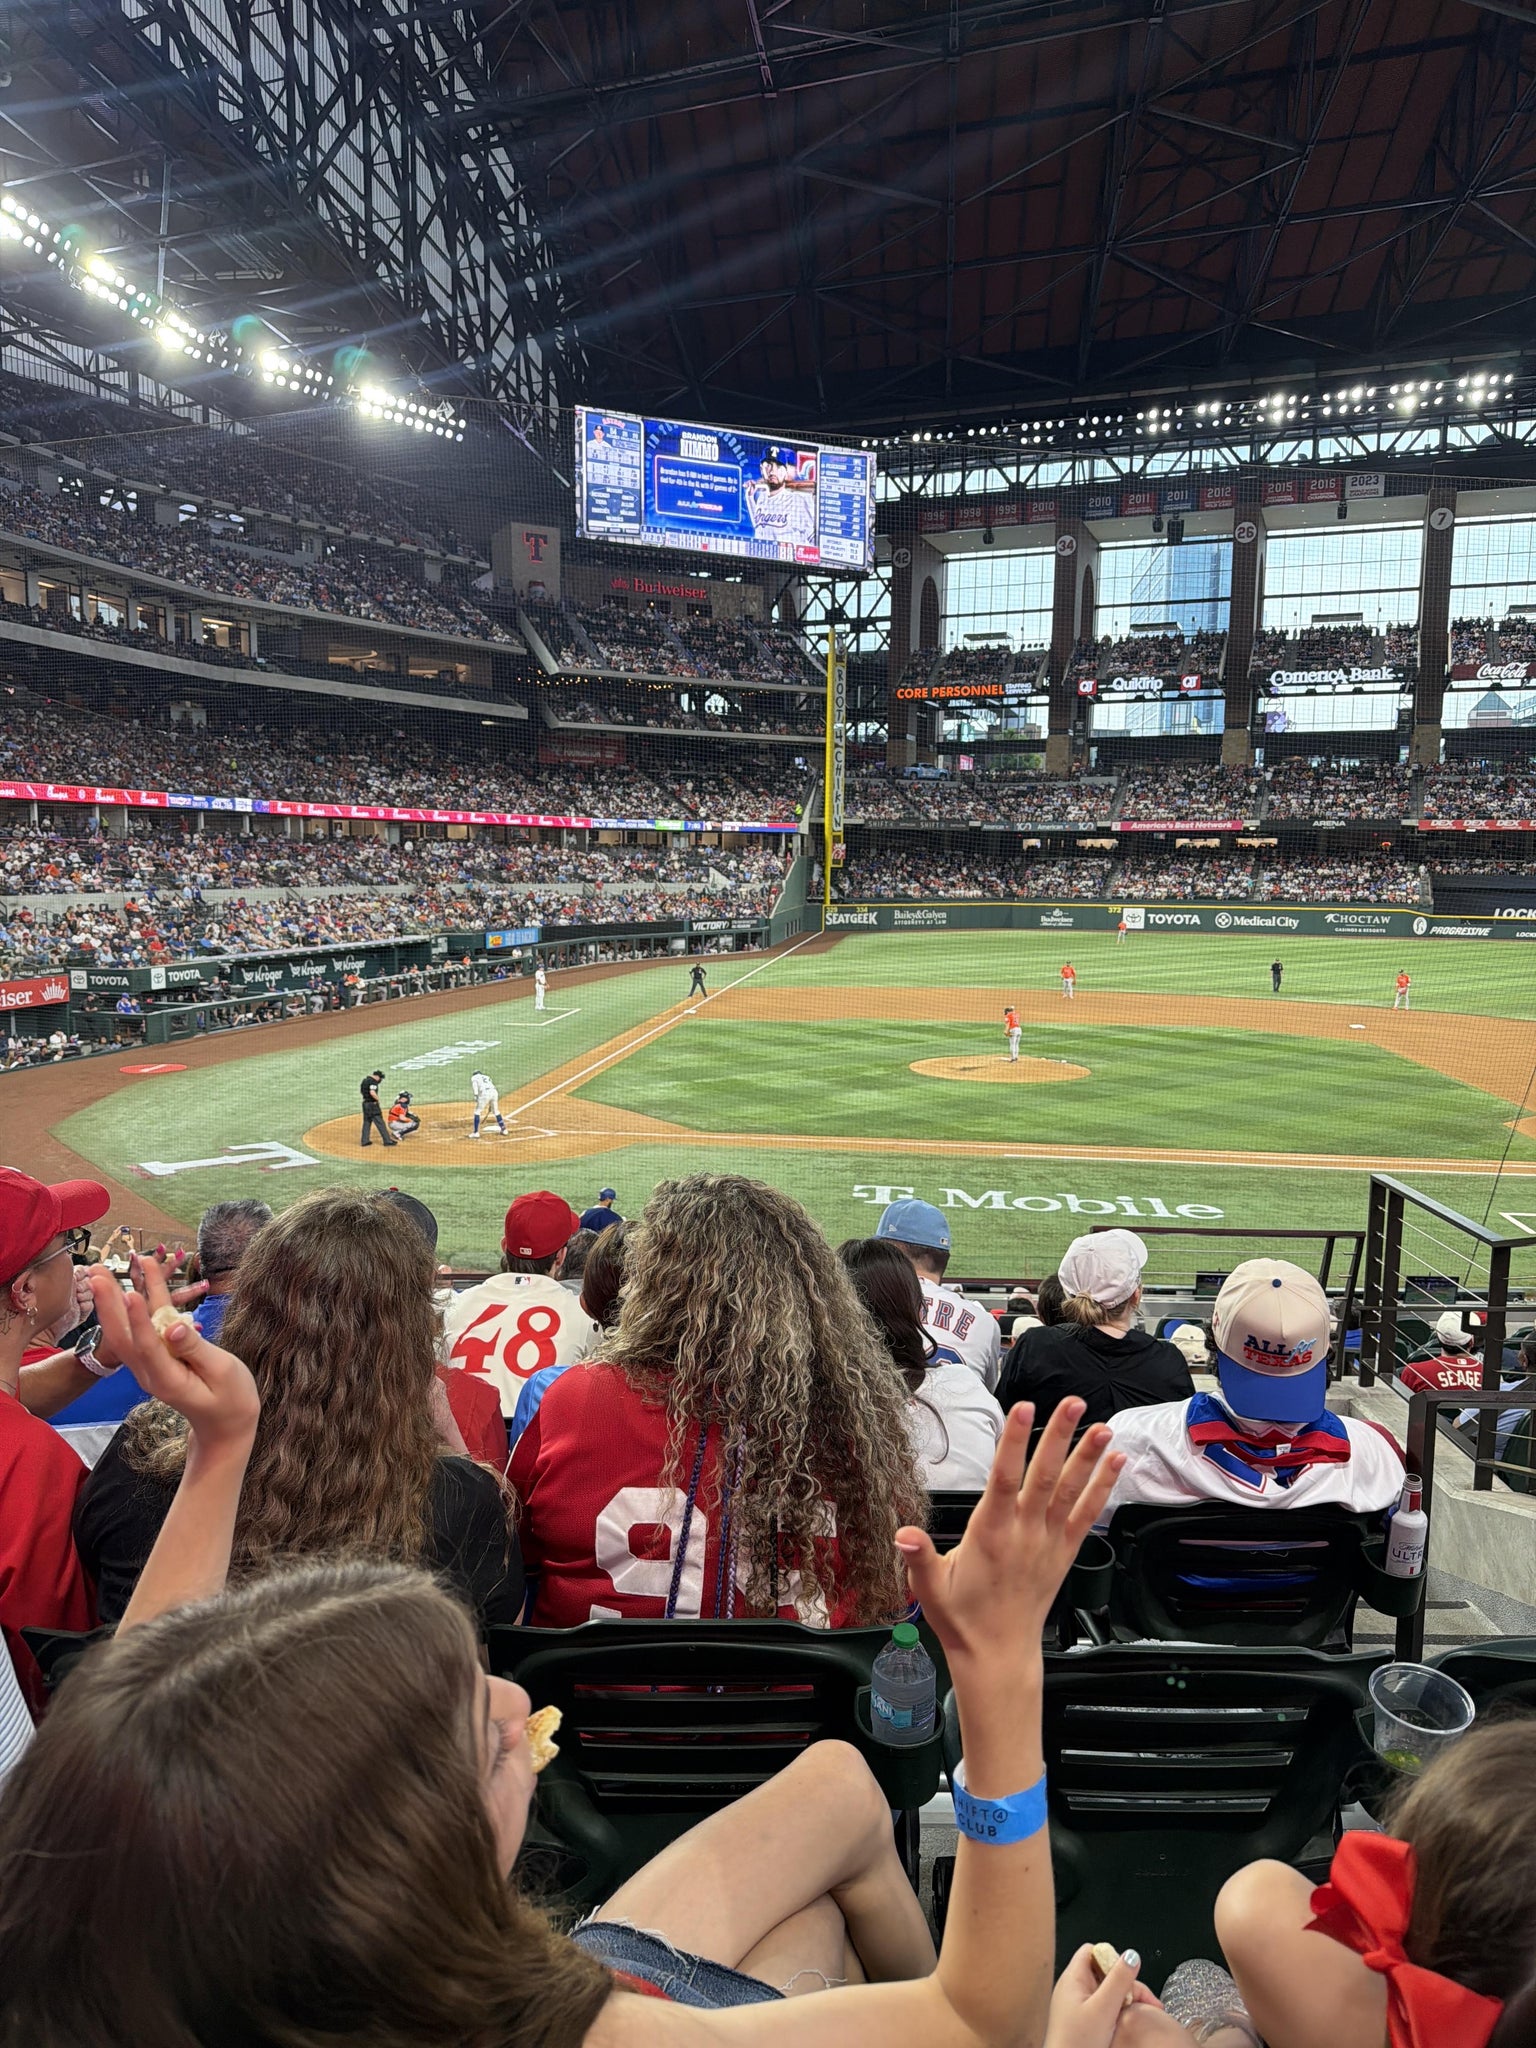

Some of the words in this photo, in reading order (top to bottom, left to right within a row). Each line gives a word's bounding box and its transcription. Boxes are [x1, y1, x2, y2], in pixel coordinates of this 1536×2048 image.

[681, 431, 718, 444] BRANDON
[680, 438, 719, 462] NIMMO
[1268, 482, 1293, 493] 2015
[1311, 479, 1336, 490] 2016
[1351, 475, 1380, 487] 2023
[1167, 490, 1188, 501] 2011
[1207, 487, 1231, 498] 2012
[1088, 496, 1112, 508] 2010
[1128, 494, 1150, 505] 2011
[959, 508, 981, 519] 1998
[995, 504, 1017, 516] 1999
[1032, 501, 1055, 513] 2010
[1437, 511, 1447, 525] 7
[1237, 526, 1255, 539] 26
[522, 530, 548, 563] T
[1058, 539, 1075, 552] 34
[893, 552, 910, 565] 42
[1349, 666, 1396, 681] Bank
[1476, 662, 1530, 679] Coca-Cola
[1079, 680, 1095, 693] QT
[1112, 676, 1164, 692] QuikTrip
[1182, 676, 1198, 688] QT
[835, 668, 845, 722] ROOT
[896, 687, 929, 699] CORE
[931, 684, 1005, 698] PERSONNEL
[835, 728, 843, 743] 4
[834, 750, 843, 829] CHIKIN
[1130, 821, 1176, 829] America's
[1177, 821, 1194, 829] Best
[1194, 821, 1233, 830] Network
[825, 911, 878, 926] SEATGEEK
[1147, 914, 1201, 925] TOYOTA
[1233, 915, 1276, 927] Medical
[1276, 916, 1300, 930] City
[1330, 912, 1392, 925] CHOCTAW
[692, 920, 728, 931] VICTORY
[1429, 926, 1493, 936] PROGRESSIVE
[301, 960, 327, 978] Kroger
[343, 955, 366, 976] Kroger
[89, 975, 130, 987] TOYOTA
[167, 969, 201, 982] TOYOTA
[254, 965, 283, 987] Kroger
[939, 1187, 1225, 1220] Mobile
[450, 1303, 561, 1379] 48
[1244, 1334, 1292, 1356] ALL
[1284, 1337, 1317, 1363] for
[1243, 1346, 1313, 1368] TEXAS
[957, 1812, 997, 1838] CLUB
